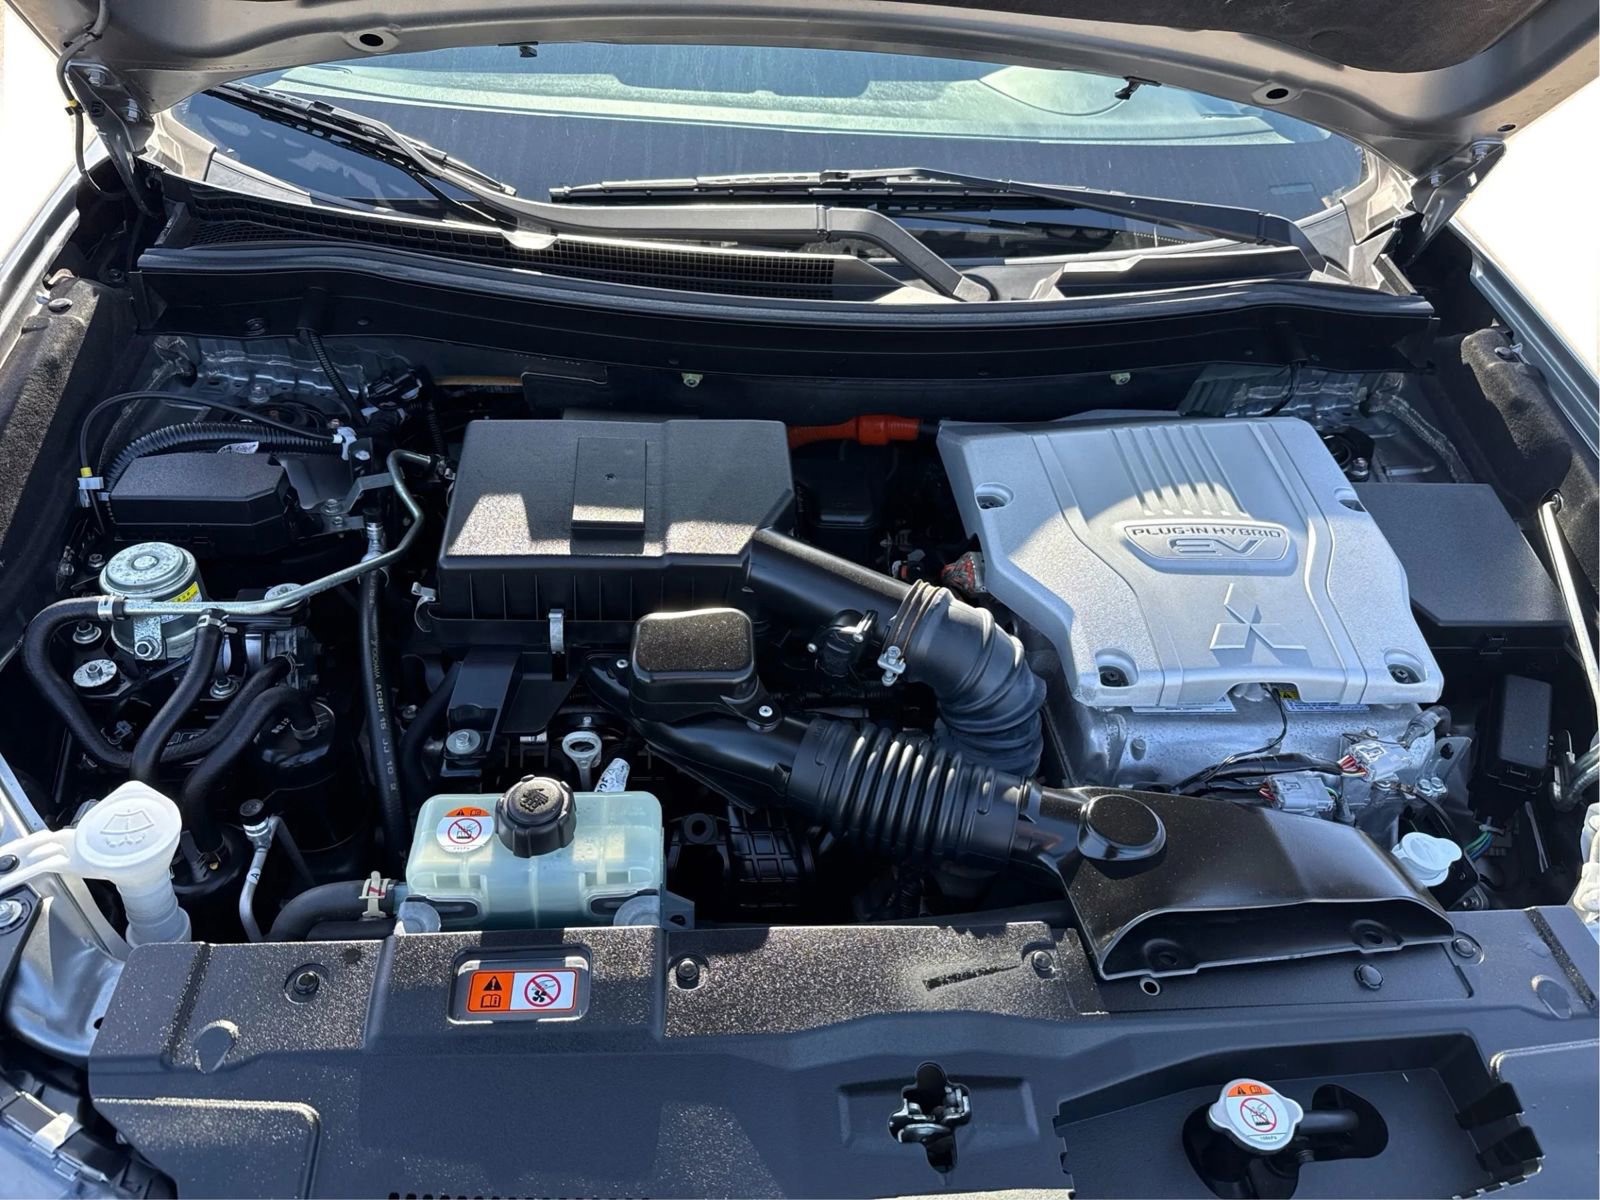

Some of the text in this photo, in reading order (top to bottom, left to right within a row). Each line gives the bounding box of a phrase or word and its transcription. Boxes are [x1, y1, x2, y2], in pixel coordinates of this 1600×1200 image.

[1132, 526, 1282, 538] PLUG-IN HYBRID
[1169, 538, 1267, 557] EV
